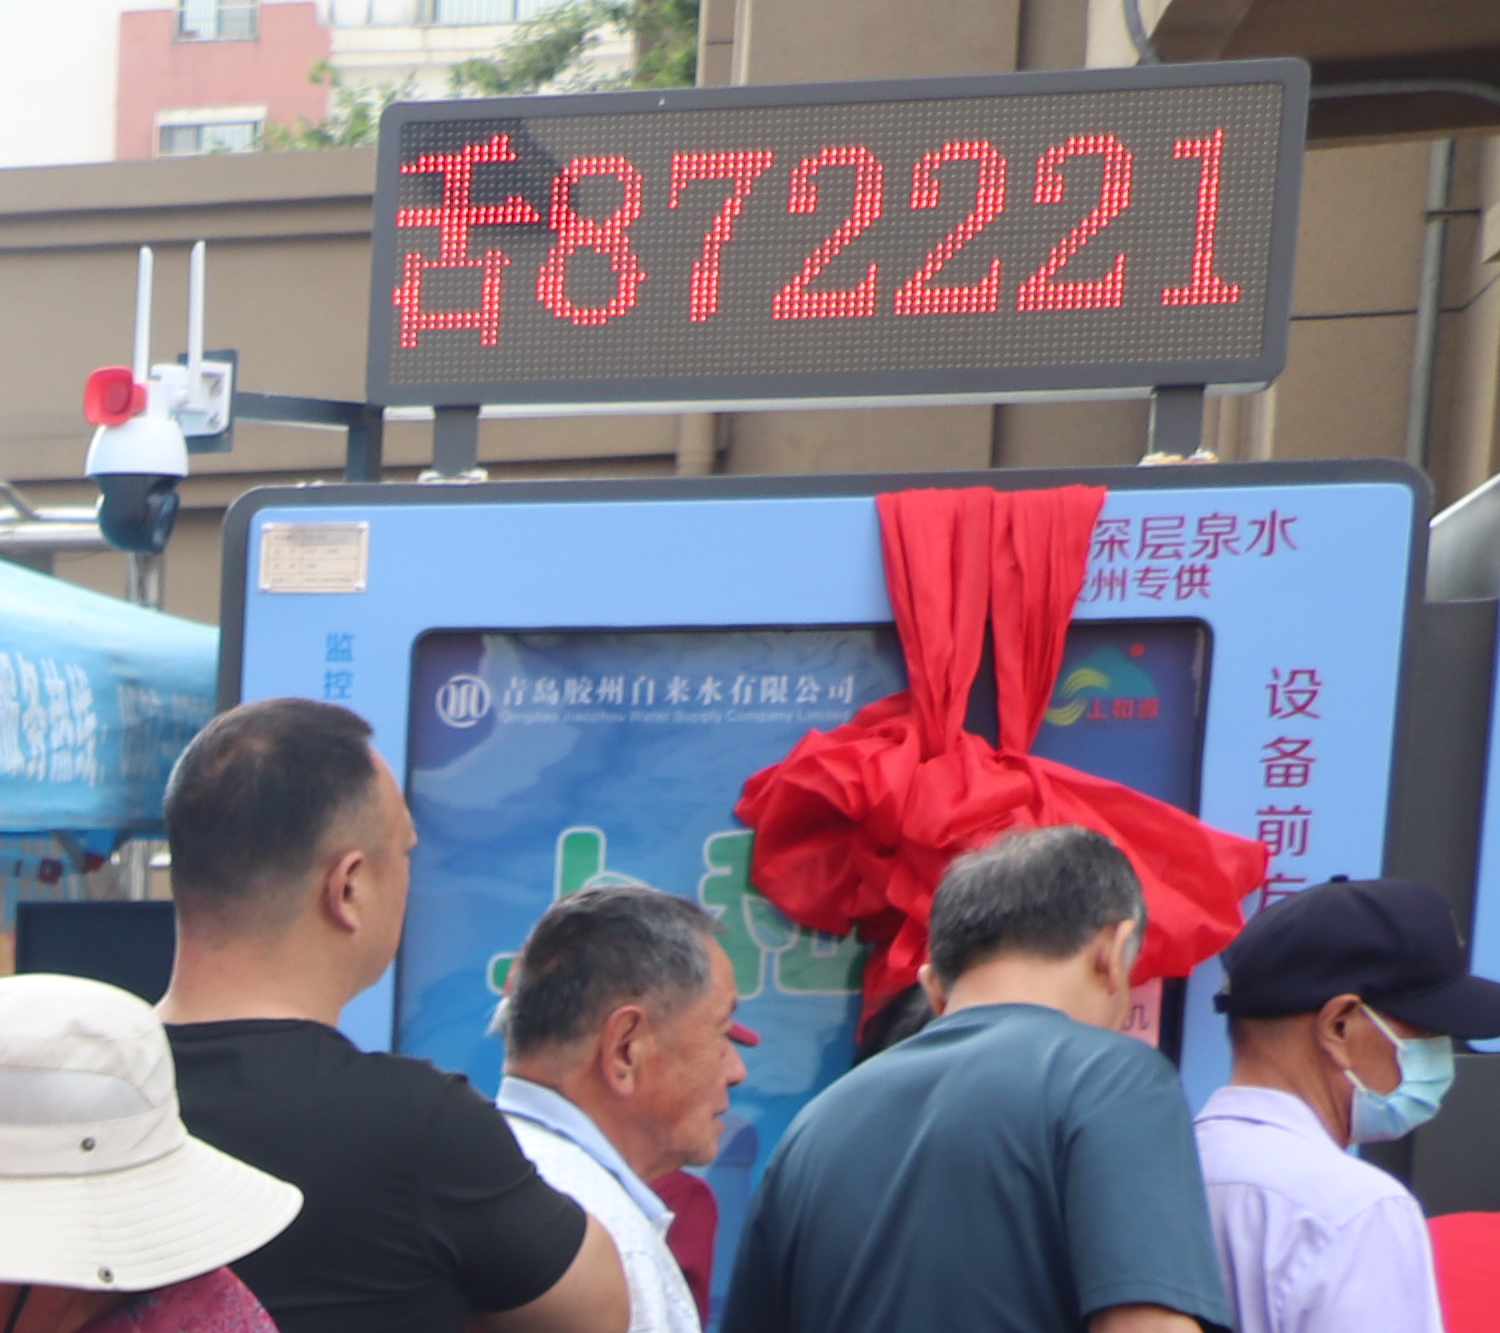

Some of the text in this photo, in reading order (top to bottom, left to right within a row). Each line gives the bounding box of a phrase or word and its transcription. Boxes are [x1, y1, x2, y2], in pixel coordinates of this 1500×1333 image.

[1092, 510, 1298, 562] 深层泉水
[1080, 563, 1211, 601] 州专供
[502, 674, 856, 706] 青岛胶州自来水有限公司
